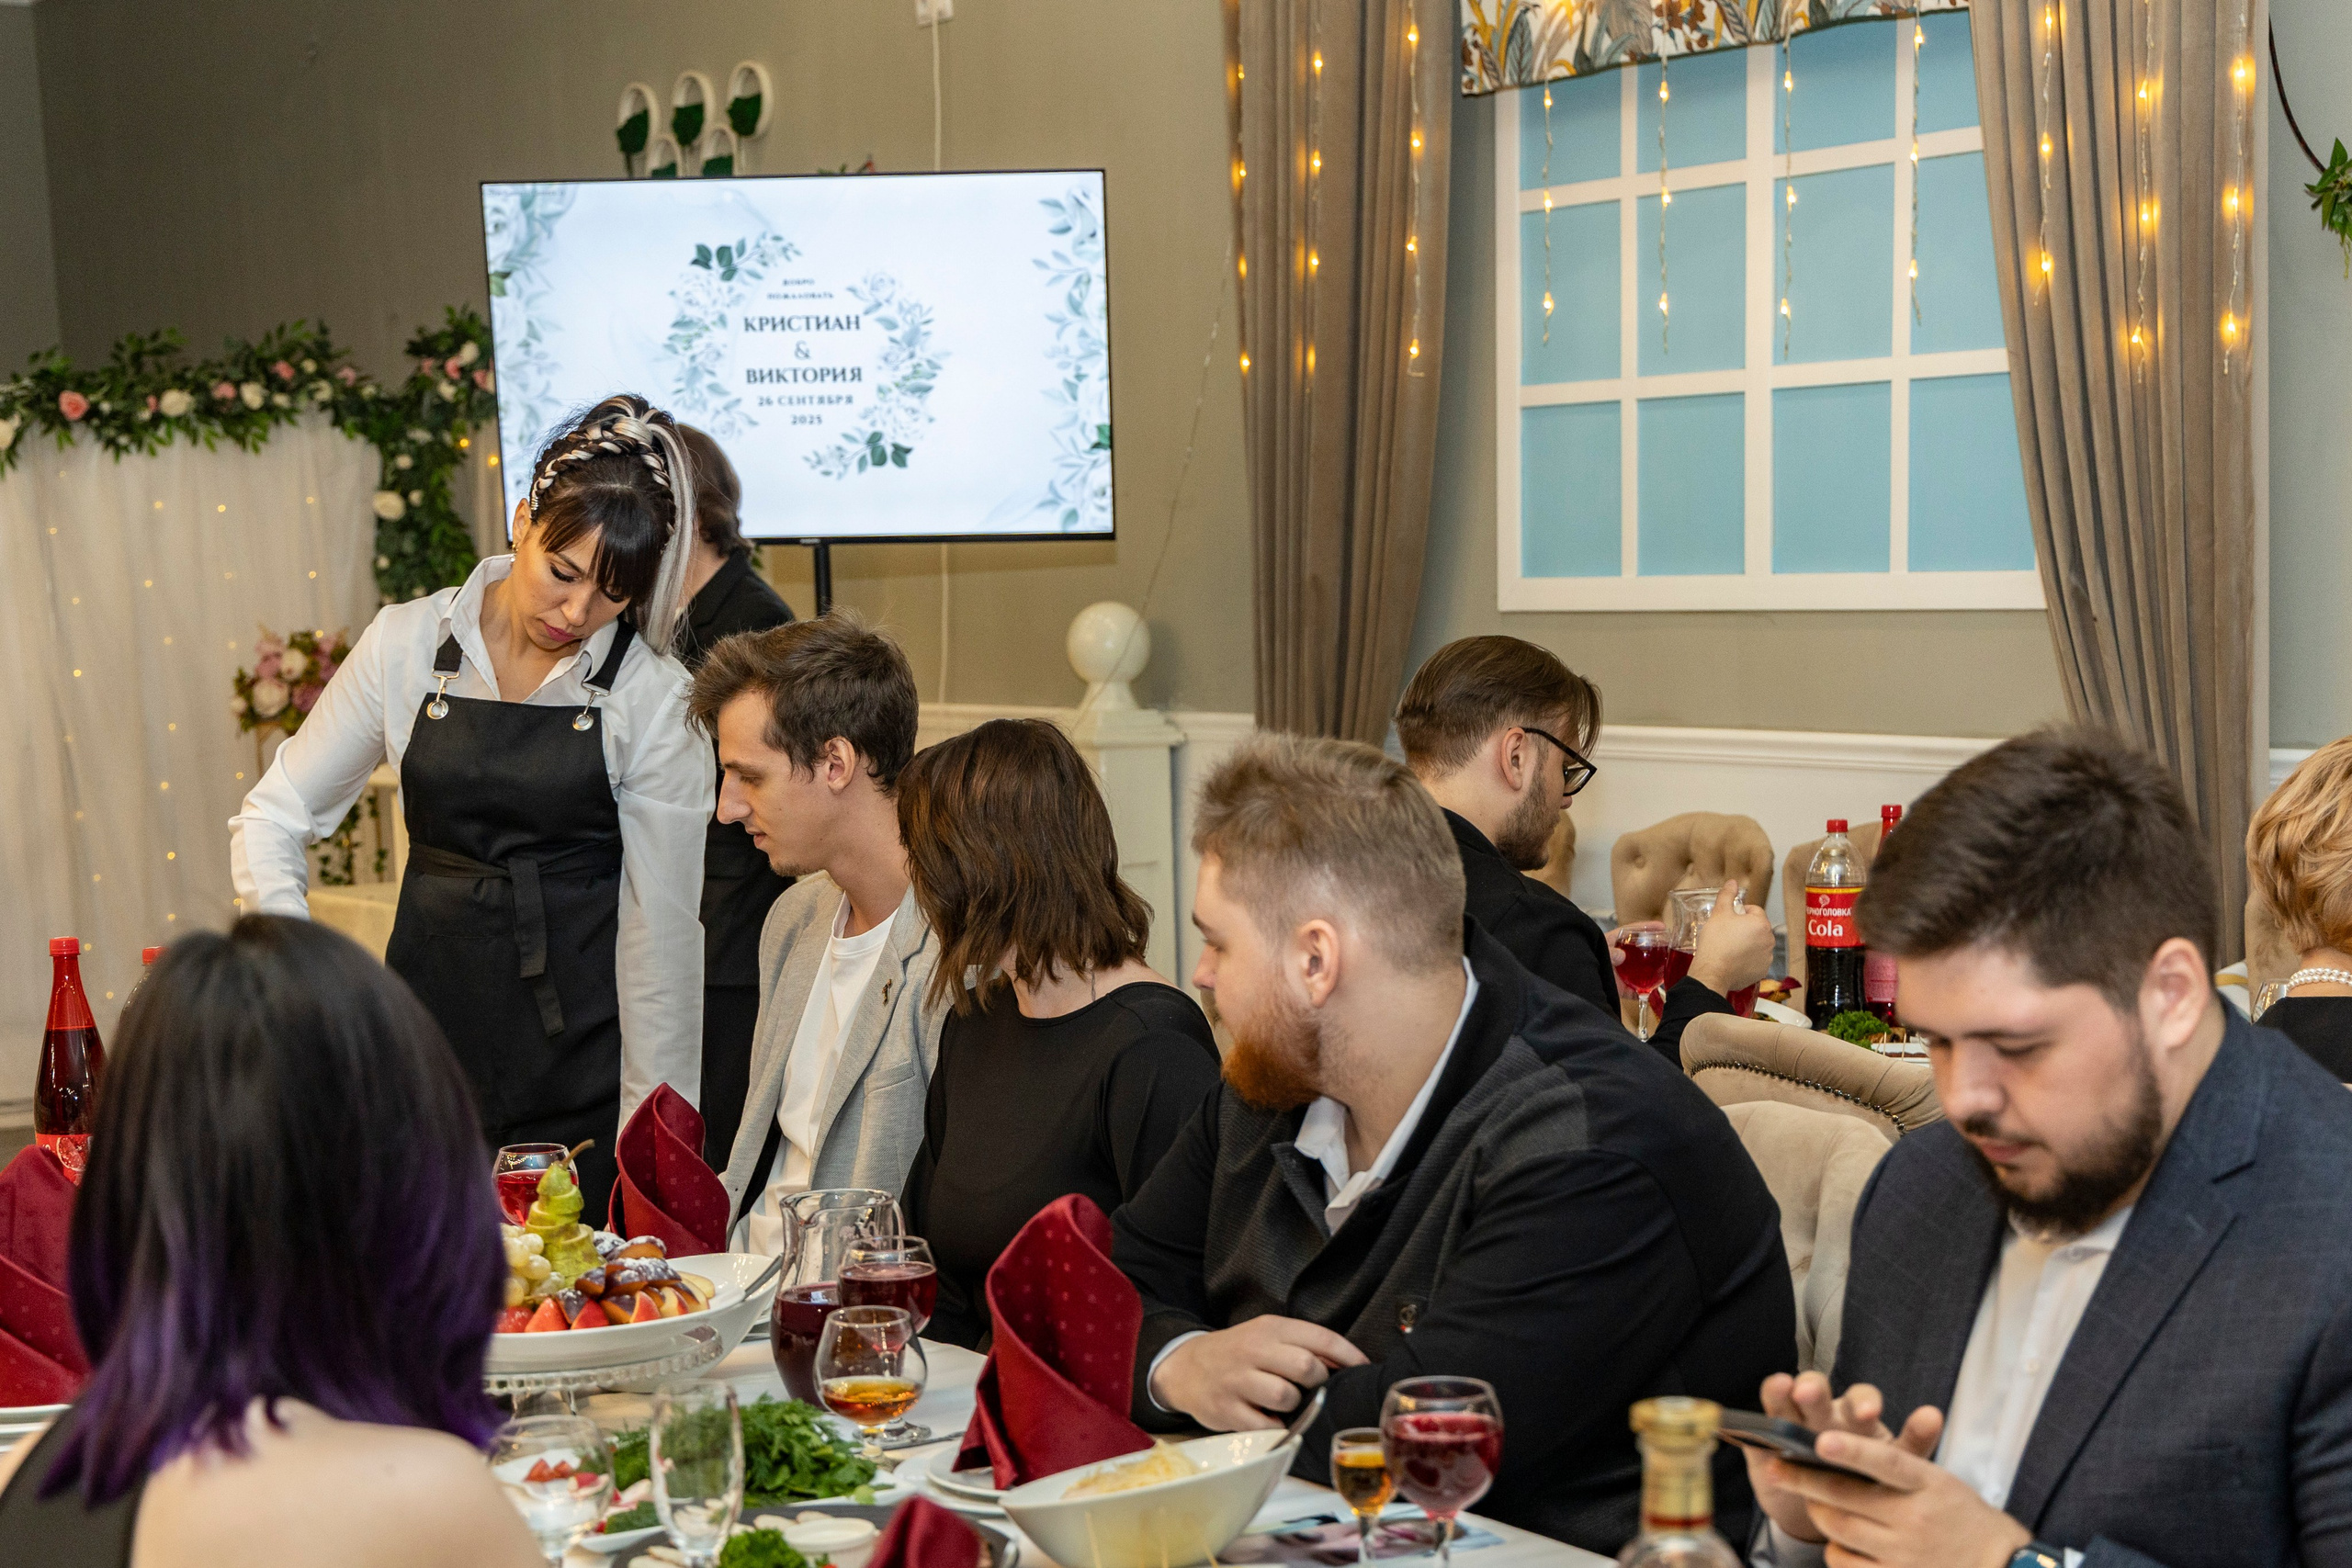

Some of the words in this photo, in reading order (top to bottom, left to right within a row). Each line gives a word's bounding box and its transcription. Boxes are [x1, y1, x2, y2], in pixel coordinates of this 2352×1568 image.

[744, 315, 860, 333] КРИСТИАН
[794, 340, 811, 360] &
[746, 367, 863, 384] ВИКТОРИЯ
[757, 396, 774, 406] 26
[777, 395, 854, 406] СЕНТЯБРЯ
[791, 414, 823, 425] 2025
[1806, 906, 1851, 917] ЕРНОГОЛОВКА
[1808, 919, 1843, 937] Cola
